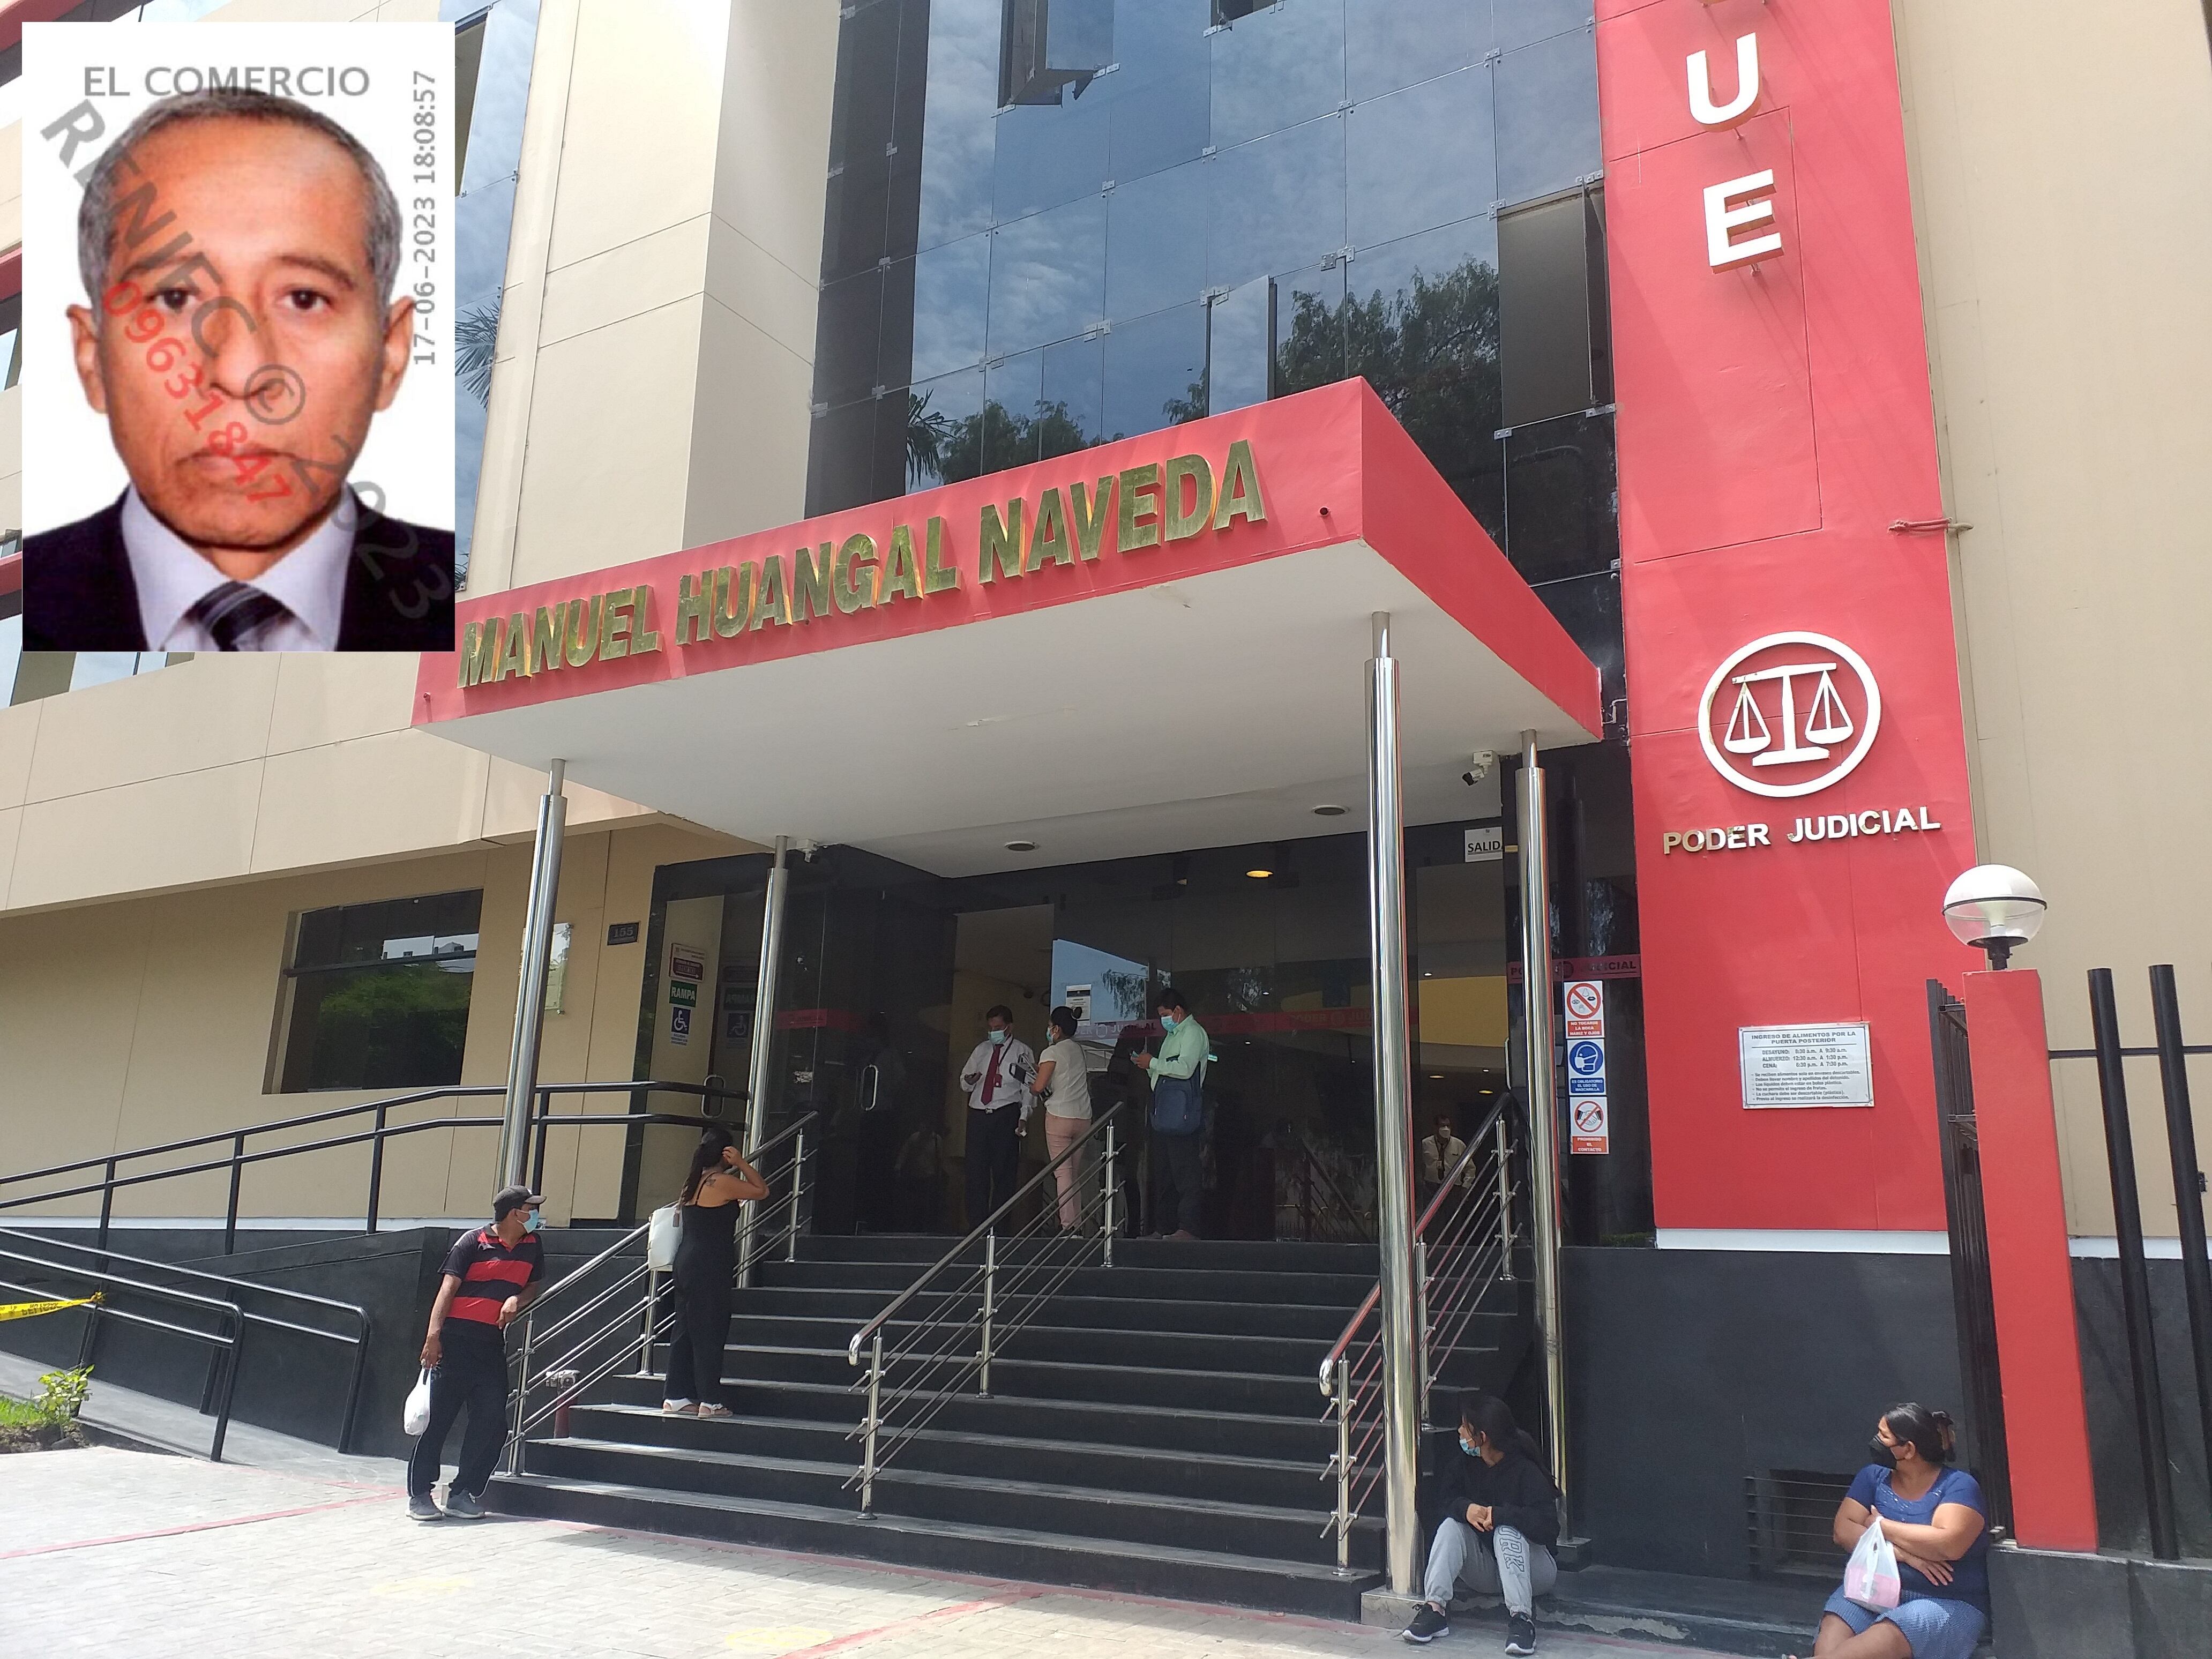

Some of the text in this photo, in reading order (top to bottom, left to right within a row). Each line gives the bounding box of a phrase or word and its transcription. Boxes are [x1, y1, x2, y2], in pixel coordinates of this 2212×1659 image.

[1686, 0, 1784, 274] UE
[457, 438, 1268, 689] MANUEL HUANGAL NAVEDA
[1468, 840, 1503, 853] SALID
[1663, 806, 1942, 855] PODER JUDICIAL
[671, 986, 696, 1001] RAMPA
